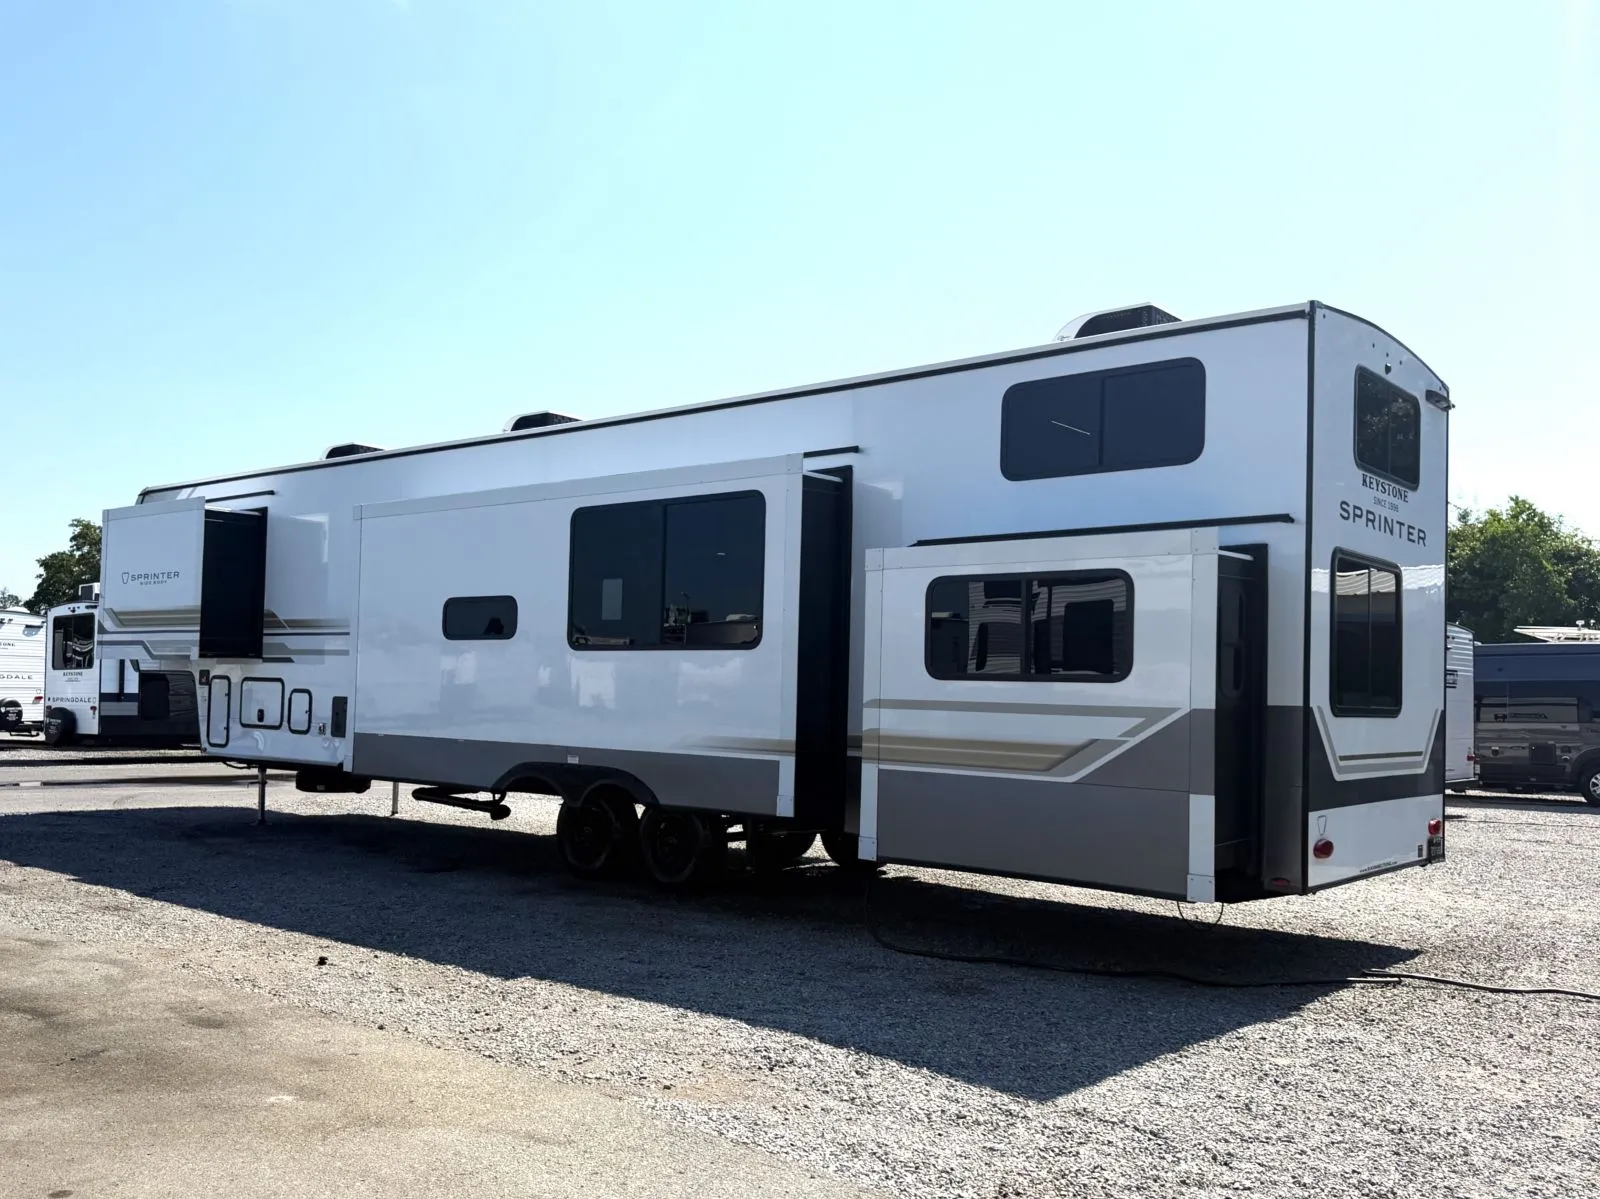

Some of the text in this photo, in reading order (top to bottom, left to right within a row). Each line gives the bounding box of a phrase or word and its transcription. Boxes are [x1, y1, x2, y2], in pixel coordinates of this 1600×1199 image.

[1362, 473, 1409, 503] KEYSTONE
[1373, 496, 1387, 509] SINCE
[1340, 500, 1426, 547] SPRINTER
[131, 571, 180, 581] SPRINTER
